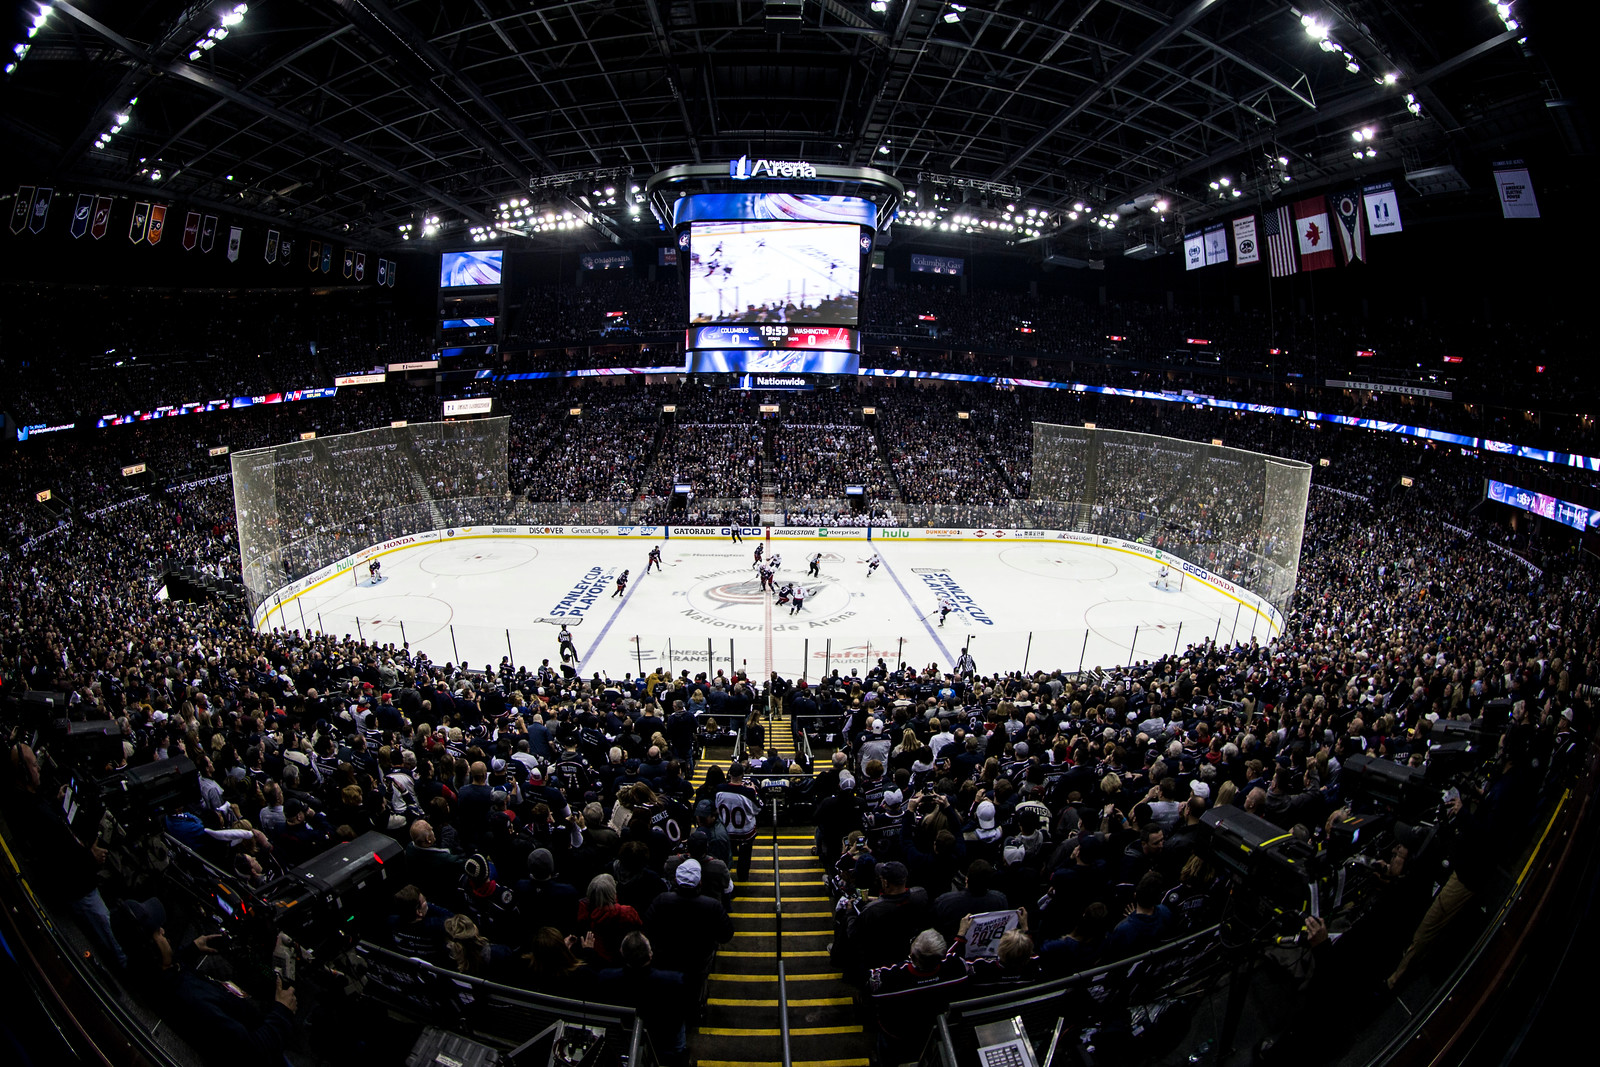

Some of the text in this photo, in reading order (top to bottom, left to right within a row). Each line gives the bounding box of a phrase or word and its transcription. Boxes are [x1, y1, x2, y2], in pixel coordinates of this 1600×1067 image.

[751, 160, 816, 178] Arena
[594, 255, 630, 264] OhioHealth
[912, 257, 961, 269] Columbia Gas
[760, 326, 788, 336] 19:59
[732, 335, 740, 344] 0
[808, 335, 816, 345] 0
[757, 377, 805, 386] Nationwide
[1347, 382, 1369, 390] LET'S
[1388, 386, 1427, 396] JACKETS
[529, 527, 564, 535] DISCOVER
[593, 527, 609, 536] Clips
[618, 527, 635, 536] SAP
[641, 527, 658, 536] SAP
[674, 528, 716, 536] GATORADE
[882, 528, 910, 538] hulu
[384, 536, 416, 551] HONDA
[336, 557, 355, 573] hulu
[1183, 562, 1208, 580] GEICO
[1208, 575, 1236, 594] HONDA
[568, 574, 614, 617] PLAYOFFS
[934, 573, 977, 606] STANLEY
[965, 606, 994, 626] CUP
[680, 608, 857, 632] Nationwide Arena
[715, 804, 744, 829] 00
